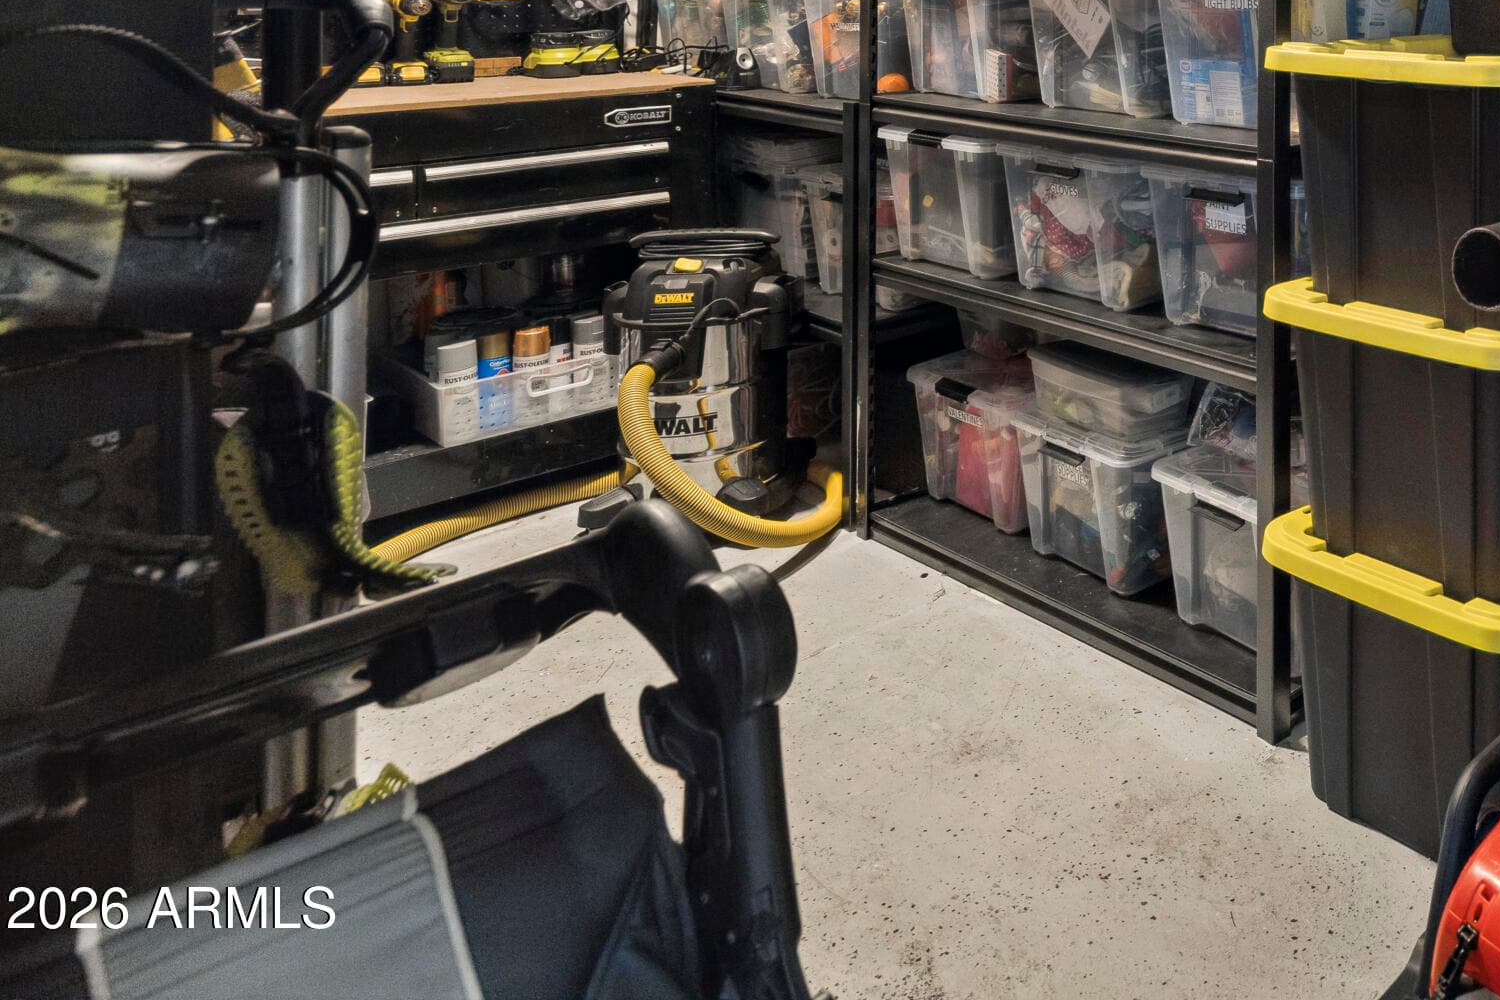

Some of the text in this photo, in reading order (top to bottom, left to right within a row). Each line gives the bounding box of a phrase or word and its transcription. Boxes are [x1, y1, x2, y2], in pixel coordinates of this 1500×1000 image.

[629, 110, 667, 121] KOBALT
[1206, 218, 1247, 234] SUPPLIES
[653, 414, 718, 436] WALT
